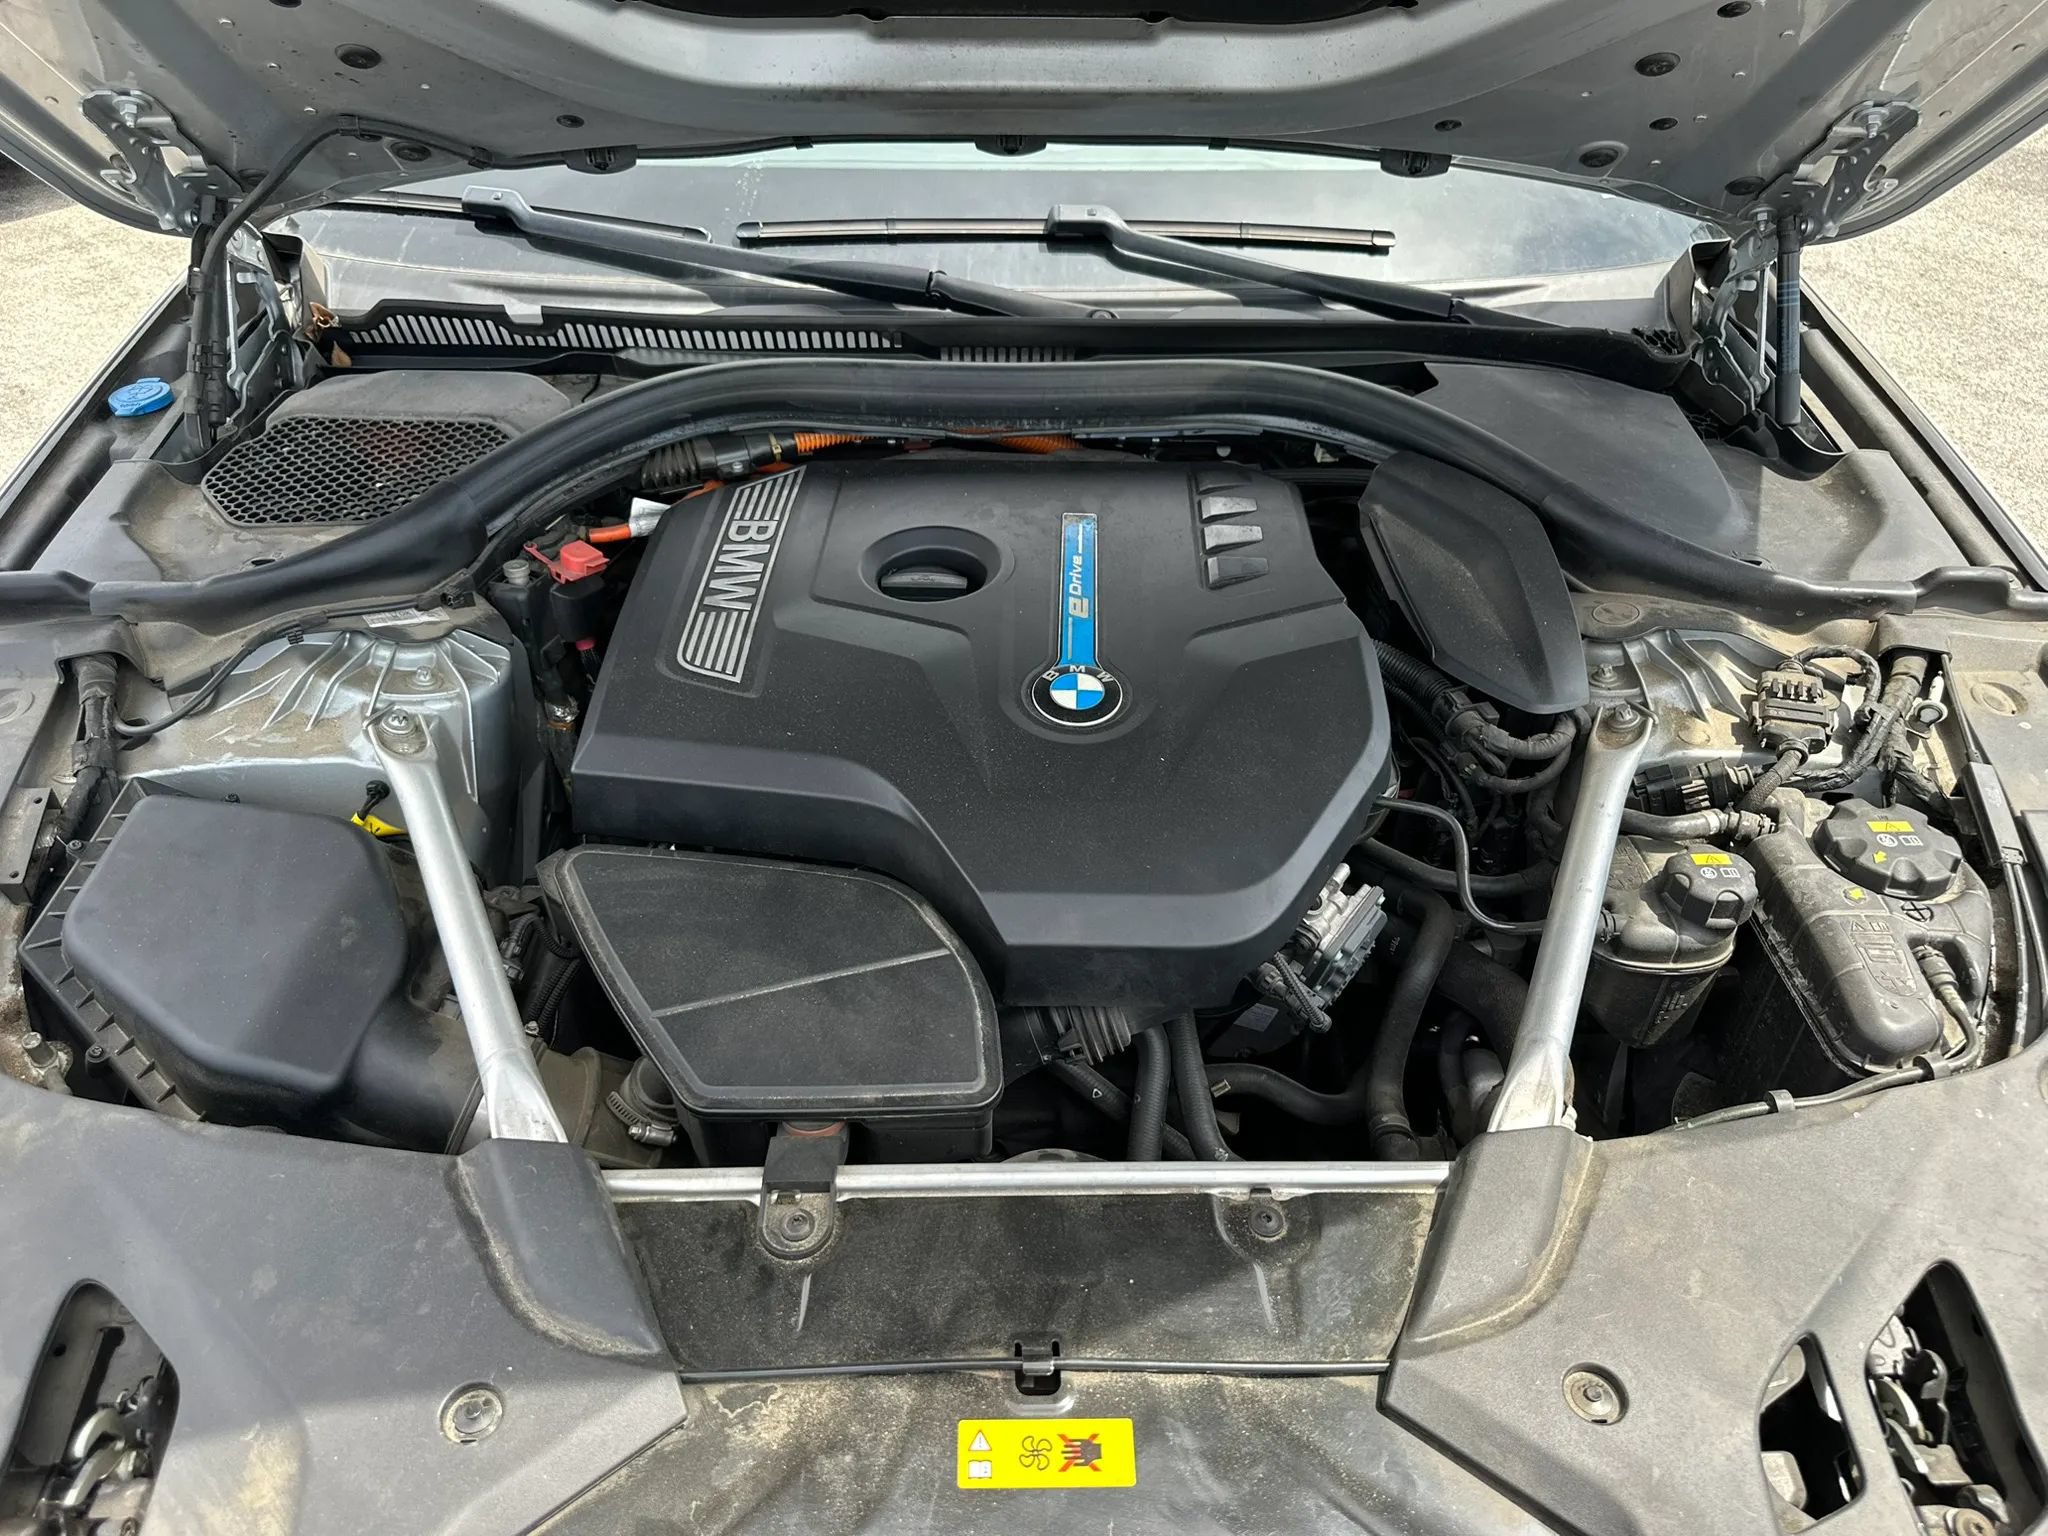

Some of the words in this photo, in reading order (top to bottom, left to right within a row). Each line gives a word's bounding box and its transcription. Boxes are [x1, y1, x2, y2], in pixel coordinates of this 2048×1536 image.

[703, 520, 778, 610] BMW
[1068, 555, 1089, 618] eDrive
[1042, 665, 1114, 683] BMW
